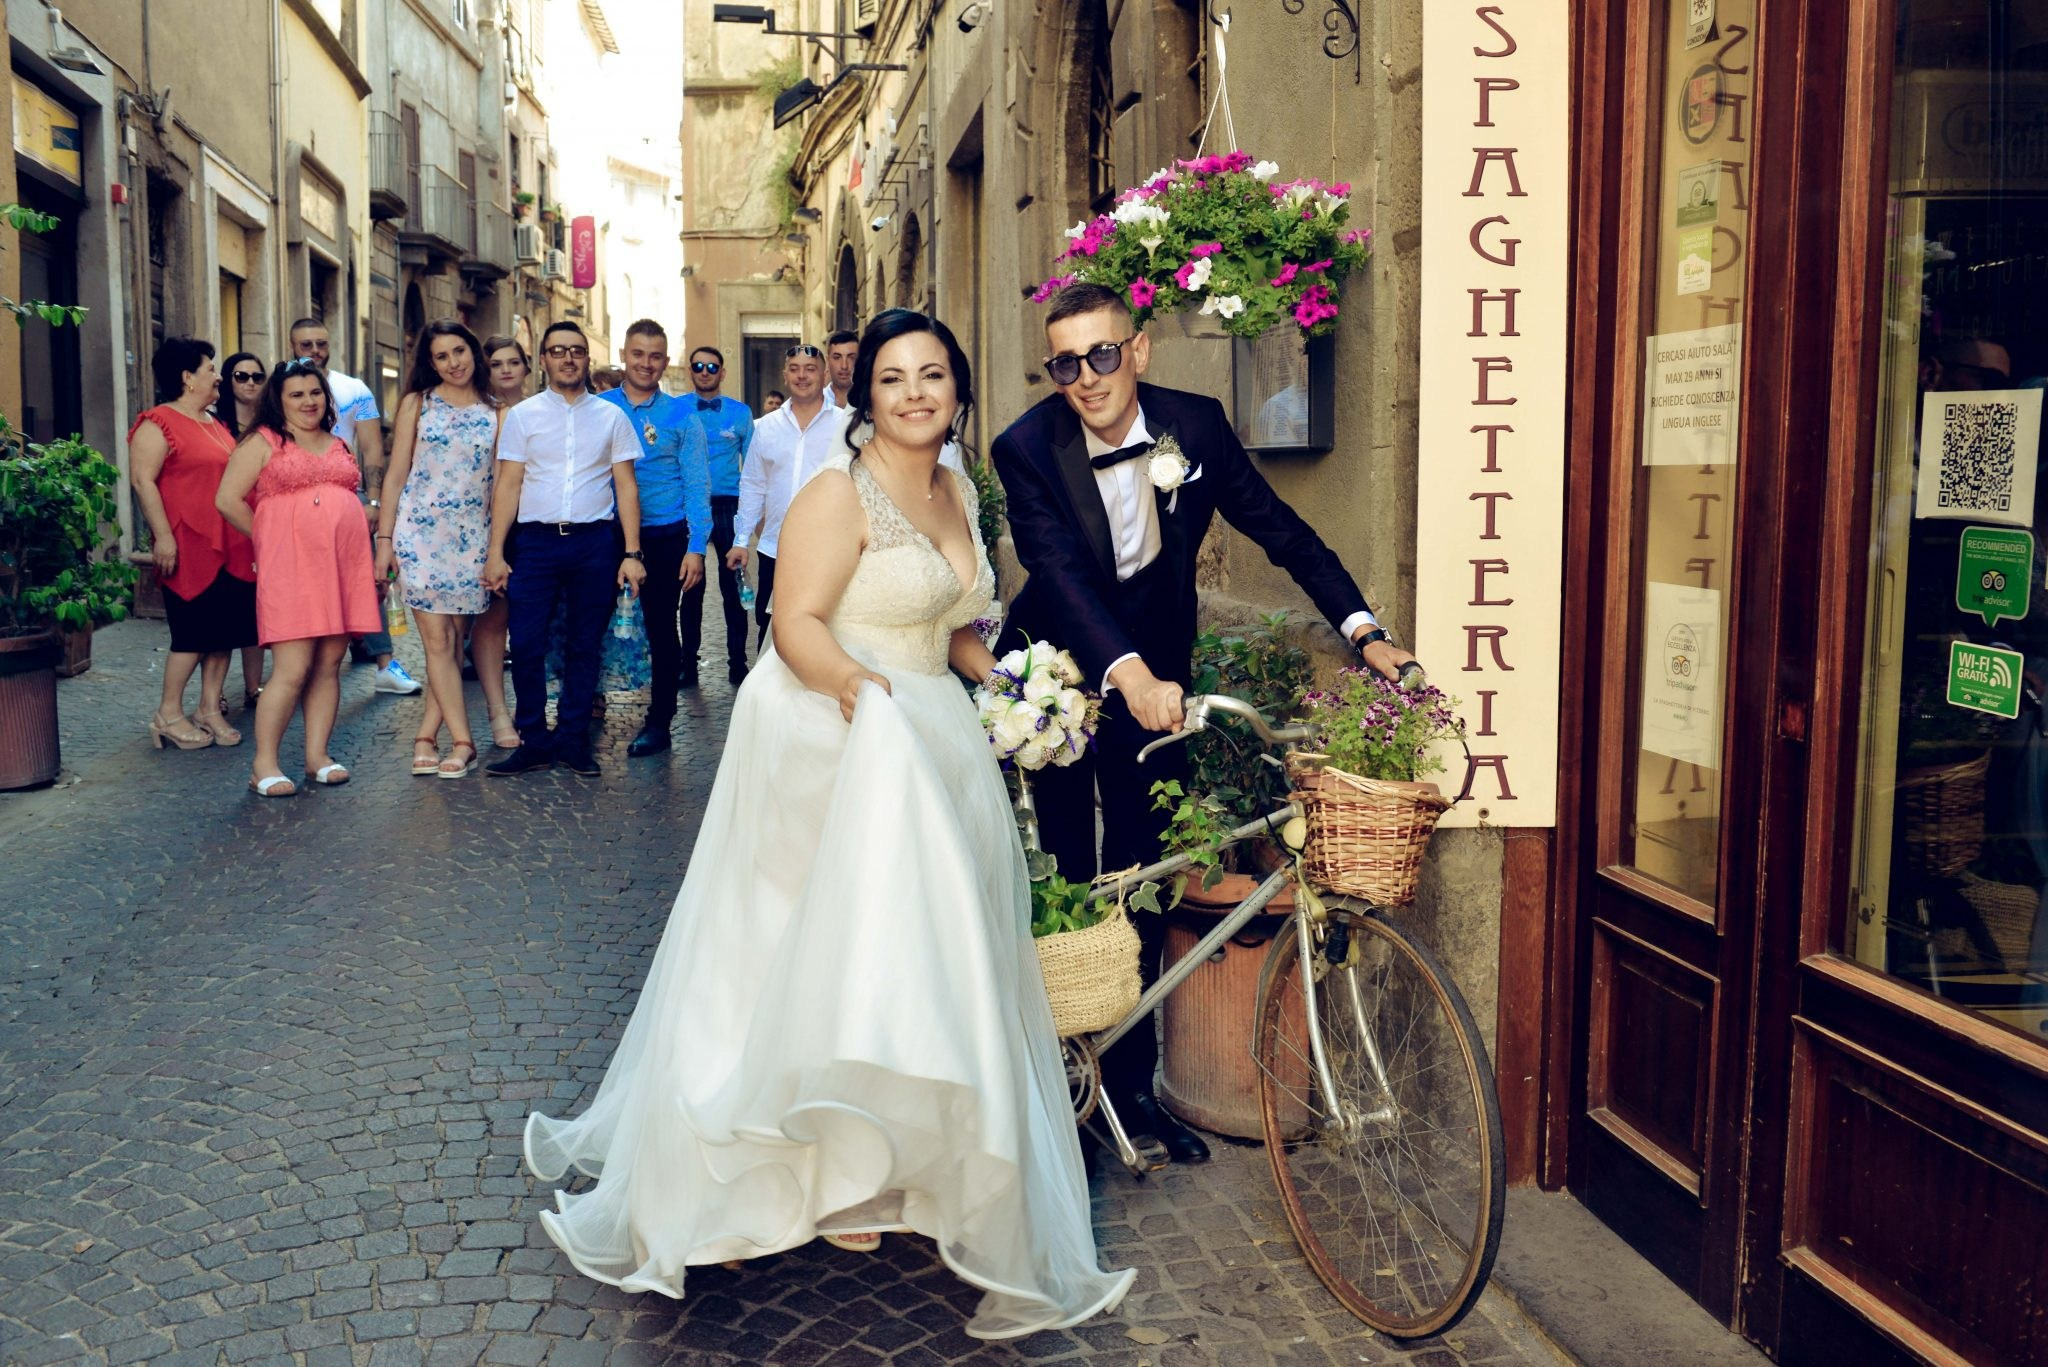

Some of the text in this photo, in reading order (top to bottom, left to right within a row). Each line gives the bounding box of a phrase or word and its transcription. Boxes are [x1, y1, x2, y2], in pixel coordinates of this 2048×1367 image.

[1657, 342, 1733, 364] CERCASI AIUTO SALA
[1665, 368, 1722, 385] MAX 29 ANNI SI
[1453, 6, 1528, 801] SPAGHETTERIA
[1651, 389, 1736, 408] RICHIEDE CONOSCENZA
[1662, 414, 1722, 429] LINGUA INGLESE
[1967, 539, 2027, 554] RECOMMENDED
[1958, 651, 1991, 672] WI-FI
[1956, 667, 1989, 684] GRATIS
